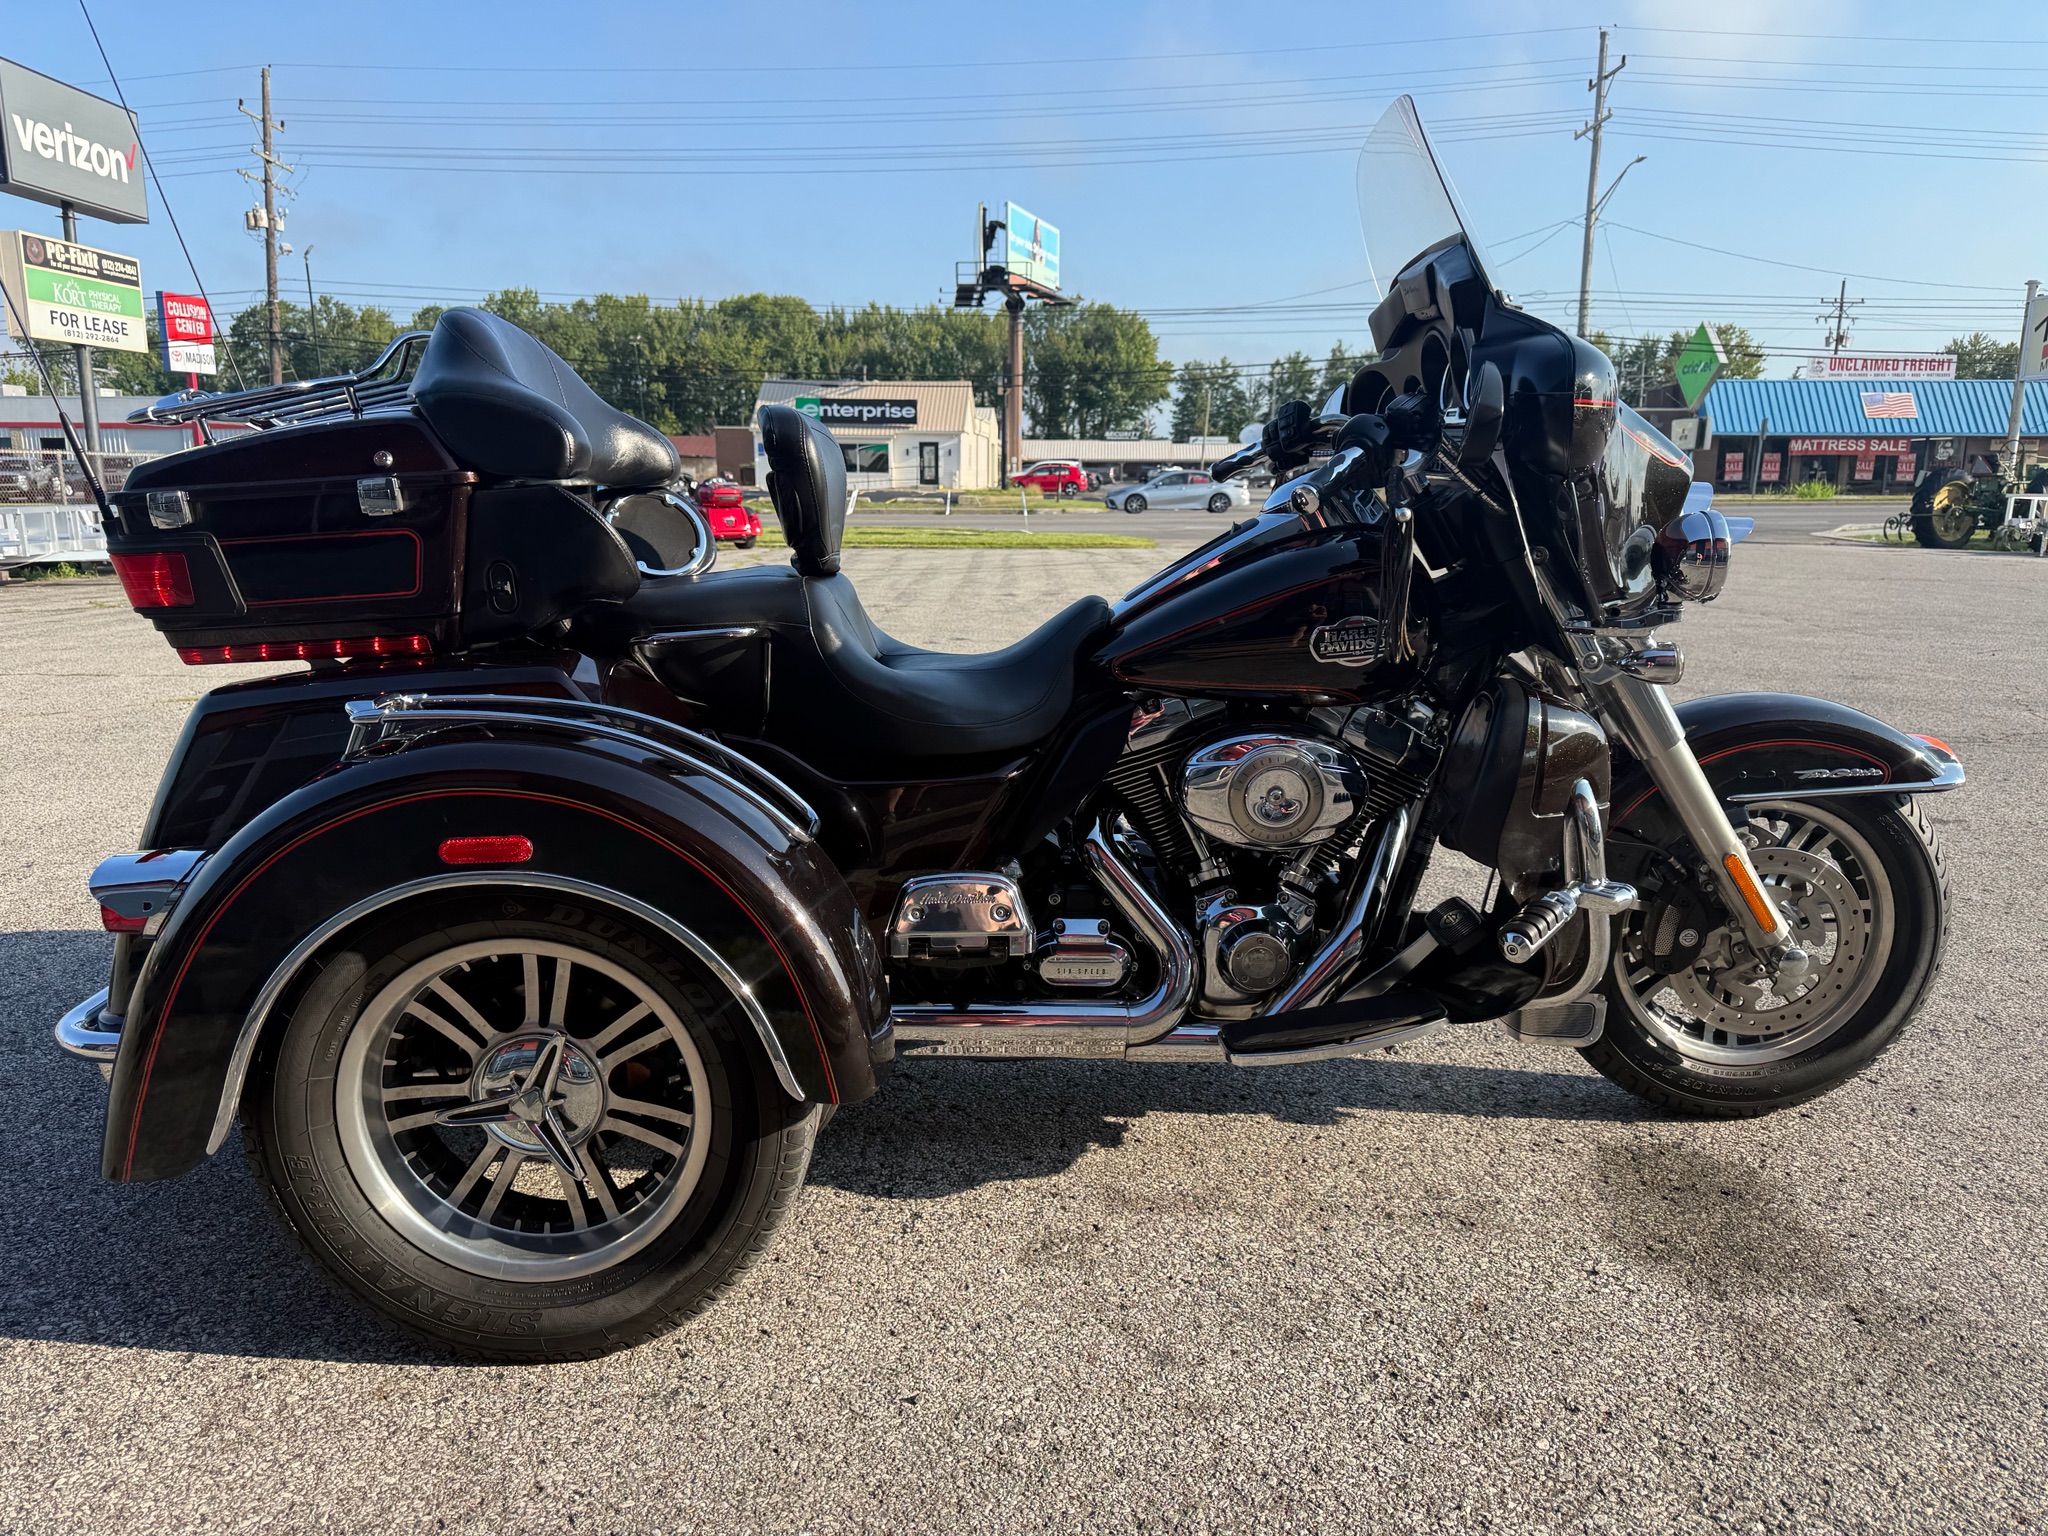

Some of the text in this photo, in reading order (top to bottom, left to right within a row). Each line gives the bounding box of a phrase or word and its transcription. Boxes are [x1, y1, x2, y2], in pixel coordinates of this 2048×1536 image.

[12, 113, 129, 184] verizon
[52, 282, 87, 307] KORT
[88, 289, 121, 304] PHYSICAL
[90, 299, 122, 313] THERAPY
[167, 301, 207, 320] COLLISION
[49, 310, 129, 336] FOR LEASE
[175, 317, 206, 335] CENTER
[64, 329, 119, 343] (812) 292-2864
[185, 351, 215, 365] MADISON
[1829, 357, 1954, 372] UNCLAIMED FREIGHT
[1682, 359, 1713, 375] cricket
[799, 402, 916, 421] enterprise
[1789, 439, 1907, 451] MATTRESS SALE
[1725, 462, 1743, 470] SALE
[1762, 462, 1780, 470] SALE
[1856, 461, 1875, 470] SALE
[1896, 462, 1915, 471] SALE
[1323, 627, 1387, 643] HARLE
[1320, 637, 1386, 653] DAVIDS
[544, 903, 736, 1043] DUNLOP
[286, 1155, 543, 1335] SIGNATURE
